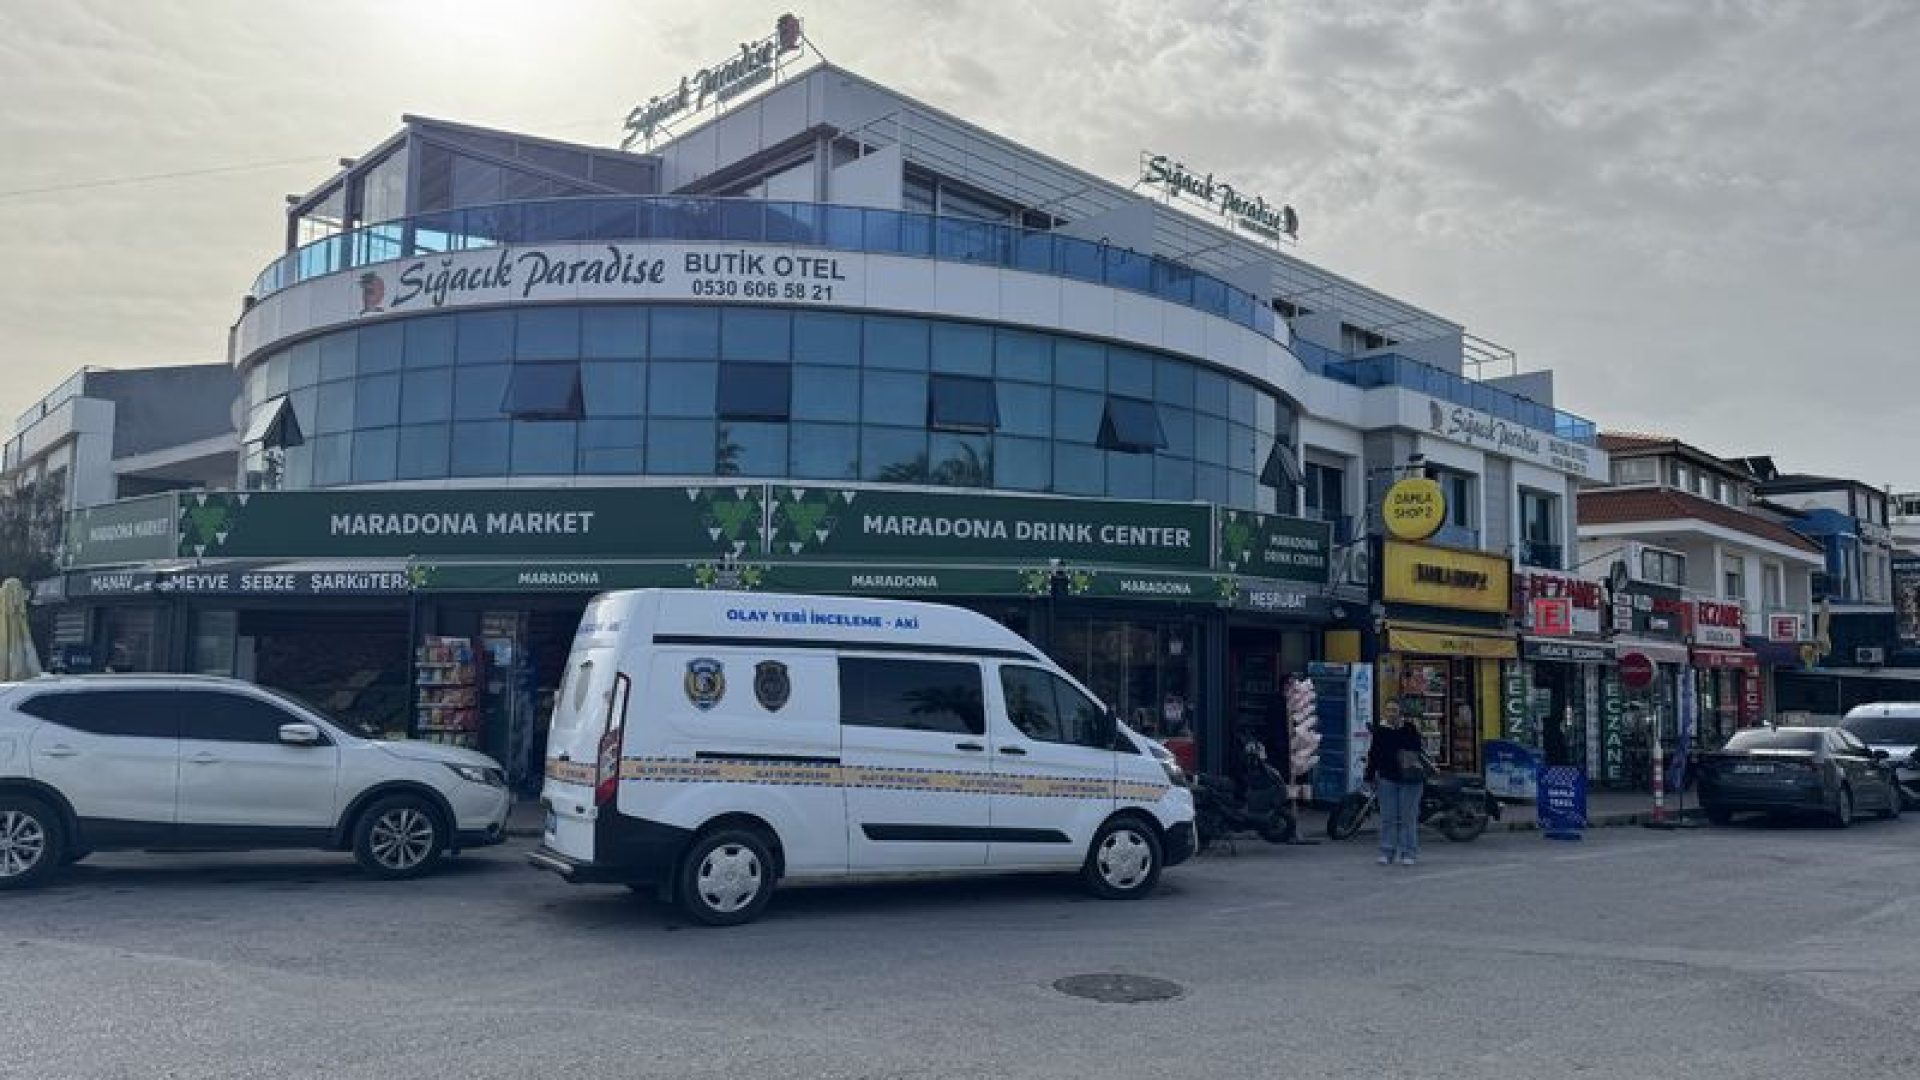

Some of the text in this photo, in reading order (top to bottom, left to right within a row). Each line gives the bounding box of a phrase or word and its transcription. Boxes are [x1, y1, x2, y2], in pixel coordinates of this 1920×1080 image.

[515, 246, 665, 298] Paradise
[684, 251, 846, 280] BUTİK OTEL
[692, 279, 833, 302] 0530 606 58 21
[1394, 492, 1433, 504] DAMLA
[1393, 507, 1423, 519] SHOP
[330, 511, 595, 536] MARADONA MARKET
[863, 514, 1191, 549] MARADONA DRINK CENTER
[173, 575, 229, 590] MEYVE
[240, 574, 296, 590] SEBZE
[518, 572, 600, 585] MARADONA
[851, 574, 938, 588] MARADONA
[1119, 579, 1192, 595] MARADONA
[726, 609, 769, 622] OLAY
[811, 609, 882, 627] İNCELEME
[1776, 620, 1796, 637] E
[1606, 683, 1622, 779] ECZANE
